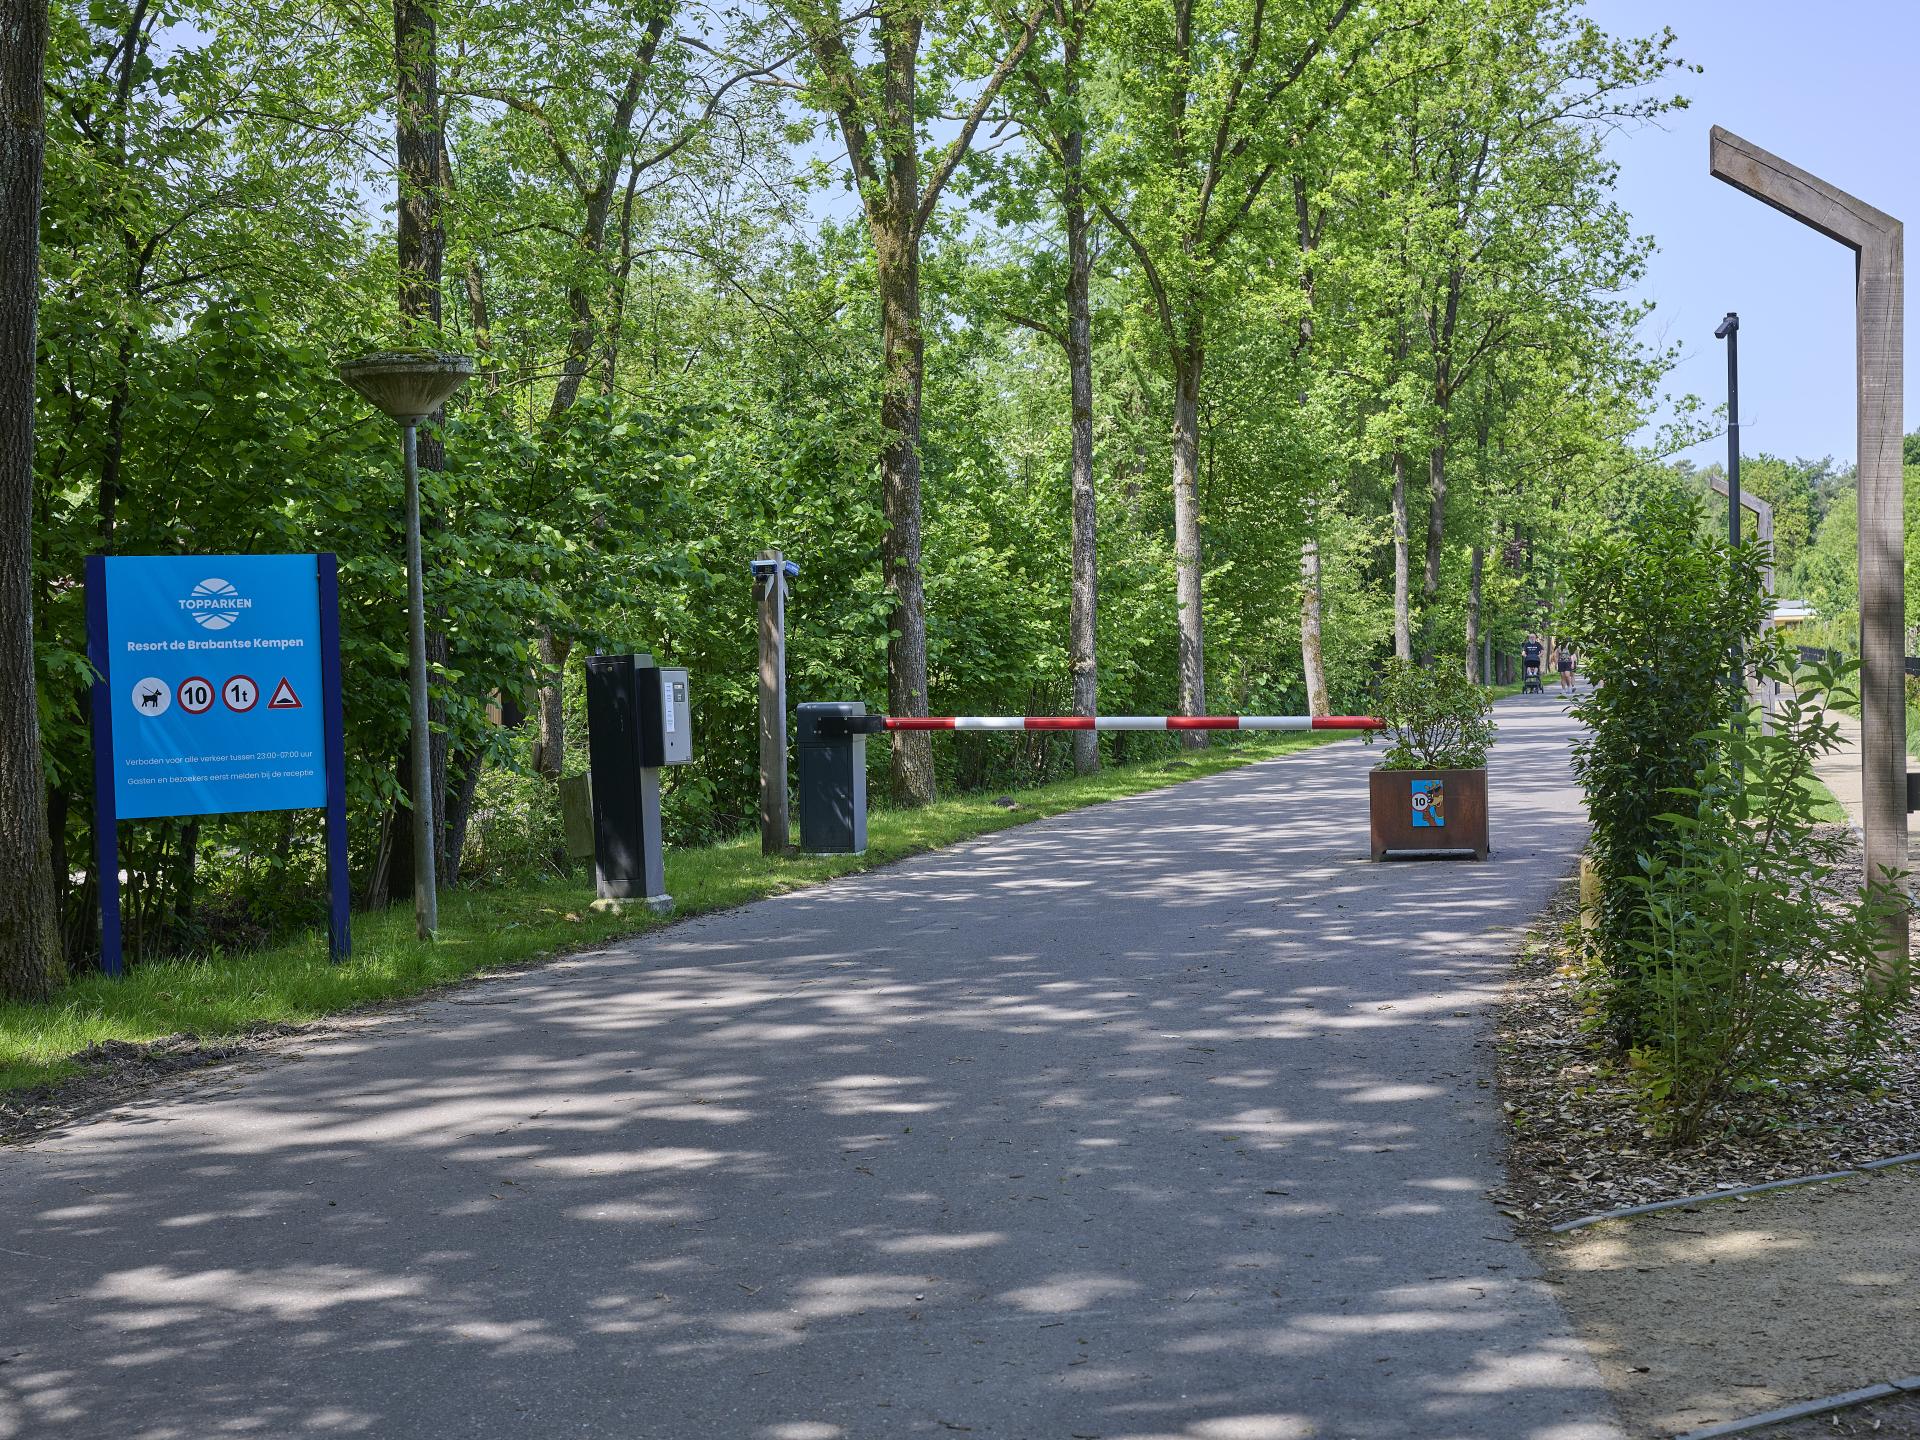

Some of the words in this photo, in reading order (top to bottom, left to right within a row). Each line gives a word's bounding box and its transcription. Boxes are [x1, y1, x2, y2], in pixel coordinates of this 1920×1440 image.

[179, 598, 252, 610] TOPPARKEN
[127, 641, 167, 651] Resort
[170, 640, 185, 650] de
[187, 639, 251, 650] Brabantse
[253, 638, 304, 650] Kempen
[184, 686, 207, 705] 10
[126, 757, 164, 766] Verboden
[127, 777, 156, 785] Gasten
[169, 775, 208, 783] bezoekers
[209, 773, 230, 781] eerst
[230, 772, 260, 780] melden
[261, 771, 271, 780] bij
[283, 770, 314, 779] receptie
[1414, 797, 1426, 807] 10
